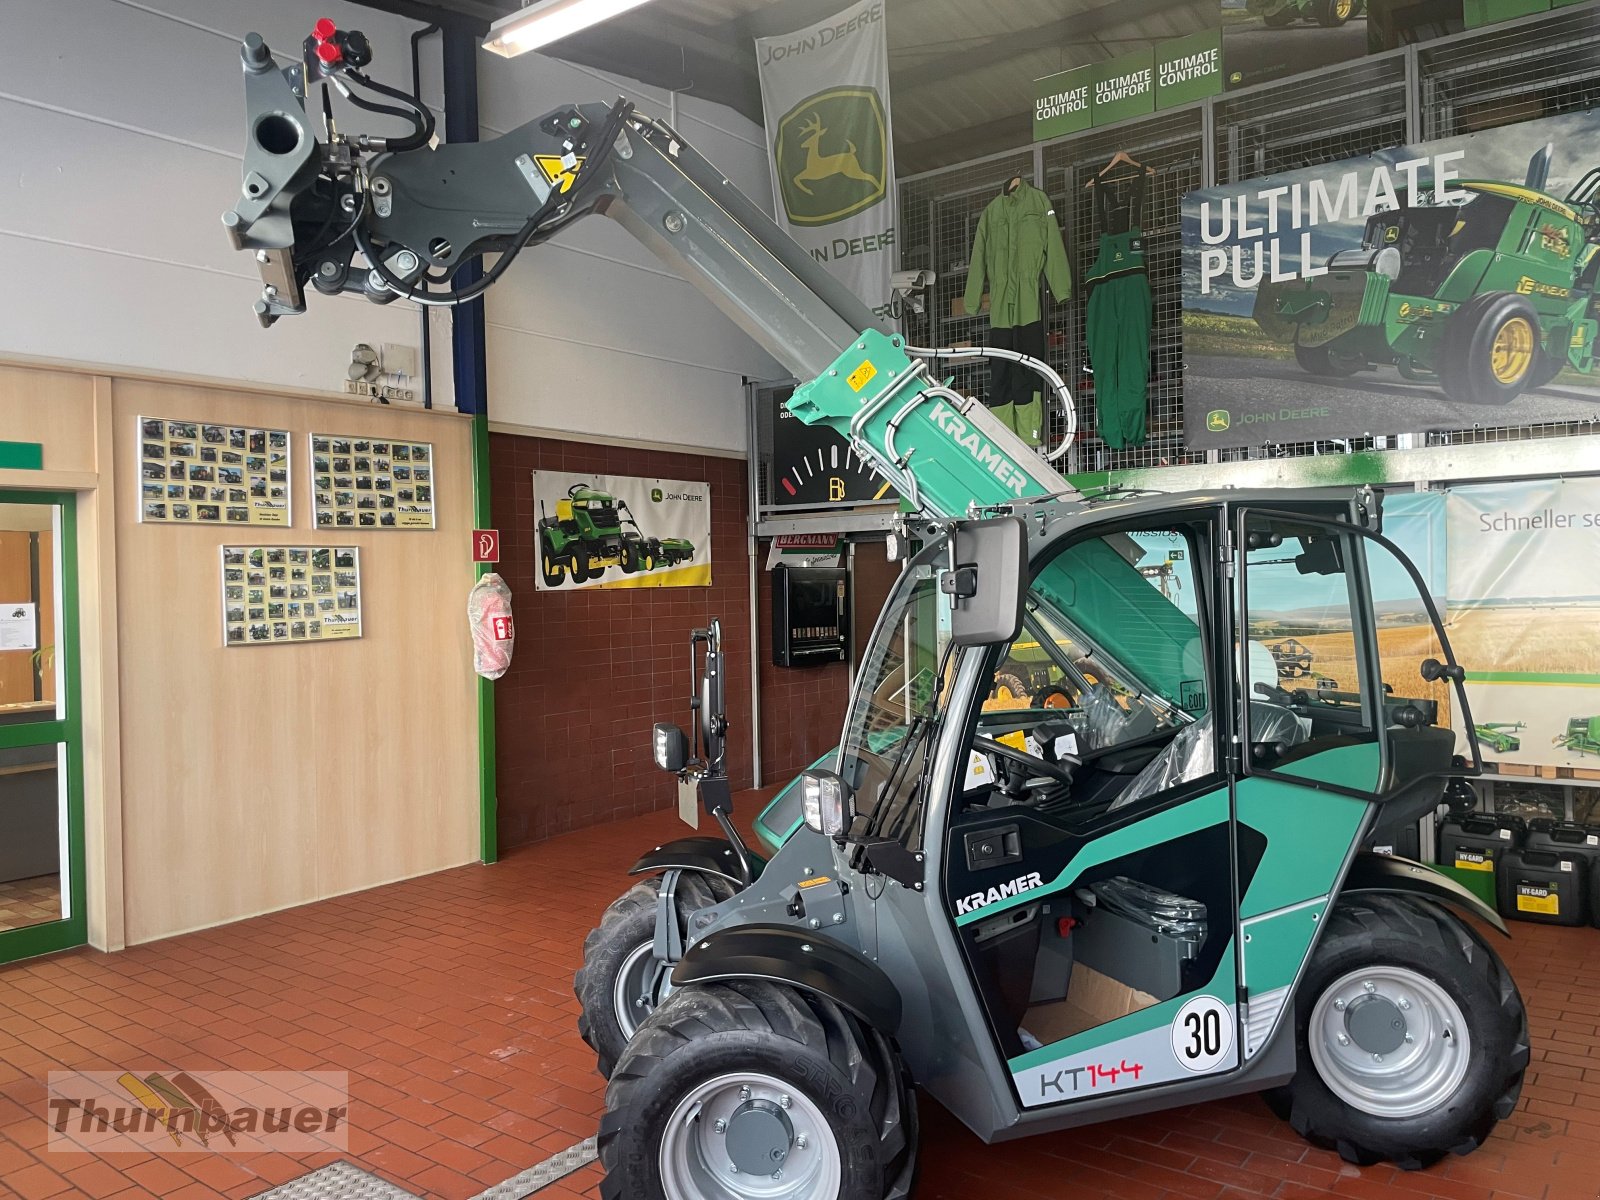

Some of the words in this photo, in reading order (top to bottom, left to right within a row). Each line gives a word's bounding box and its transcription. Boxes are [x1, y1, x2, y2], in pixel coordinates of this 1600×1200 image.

[763, 37, 816, 66] JOHN
[818, 2, 882, 47] DEERE
[1159, 48, 1218, 76] ULTIMATE
[1159, 62, 1218, 87] CONTROL
[1095, 68, 1152, 94] ULTIMATE
[1095, 80, 1152, 105] COMFORT
[1036, 86, 1089, 110] ULTIMATE
[1036, 98, 1089, 120] CONTROL
[1201, 150, 1466, 245] ULTIMATE
[1201, 232, 1329, 294] PULL
[1236, 412, 1276, 426] JOHN
[1279, 406, 1330, 422] DEERE
[928, 402, 1028, 497] KRAMER
[665, 492, 682, 501] JOHN
[682, 493, 703, 502] DEERE
[1479, 508, 1577, 533] Schneller
[780, 533, 837, 545] BERGMANN
[1460, 853, 1484, 863] HY-GARD
[956, 871, 1044, 916] KRAMER
[1521, 886, 1548, 897] HY-GARD
[1184, 1008, 1221, 1059] 30
[1040, 1059, 1144, 1097] KT144
